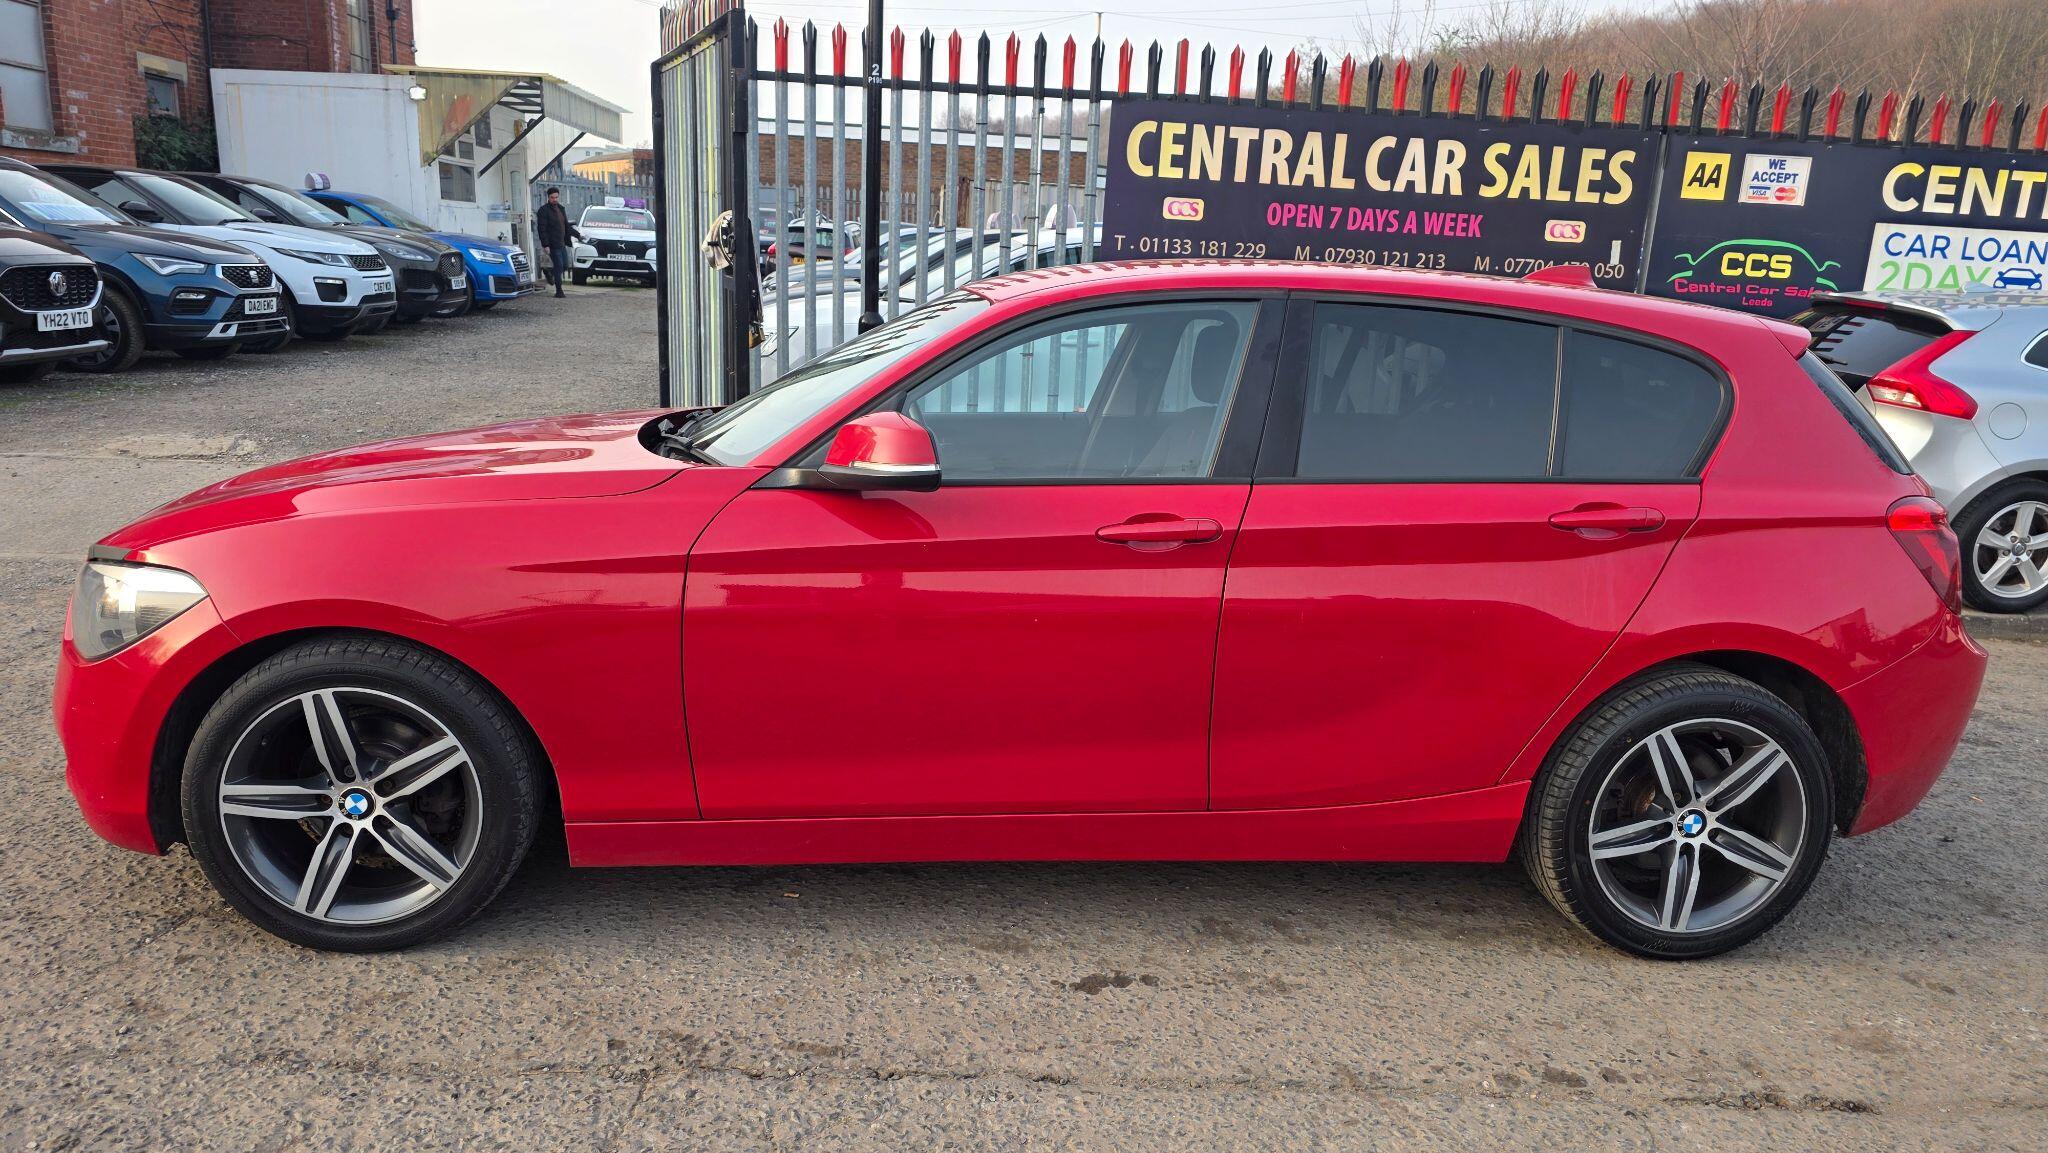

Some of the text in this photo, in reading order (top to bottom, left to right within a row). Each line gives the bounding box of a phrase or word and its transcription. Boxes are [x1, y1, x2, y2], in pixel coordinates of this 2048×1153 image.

[871, 63, 880, 76] 2
[1126, 120, 1636, 205] CENTRAL CAR SALES
[1768, 159, 1787, 170] WE
[1687, 163, 1722, 188] AA
[1752, 171, 1799, 184] ACCEPT
[1167, 200, 1200, 217] CCS
[1266, 202, 1484, 238] OPEN 7 DAYS A WEEK
[1549, 223, 1582, 240] CCS
[1884, 232, 1951, 260] CAR
[1139, 237, 1192, 255] 01133
[1200, 240, 1227, 257] 181
[1233, 242, 1266, 259] 229
[1324, 247, 1376, 264] 07930
[1382, 251, 1409, 267] 121
[1416, 252, 1446, 269] 213
[1594, 262, 1625, 279] 050
[1720, 252, 1793, 279] CCS
[1875, 260, 1992, 291] 2DAY
[1674, 278, 1741, 294] Central
[1746, 285, 1780, 295] Car
[1742, 296, 1773, 307] Leeds
[43, 311, 89, 328] YH22 VTO
